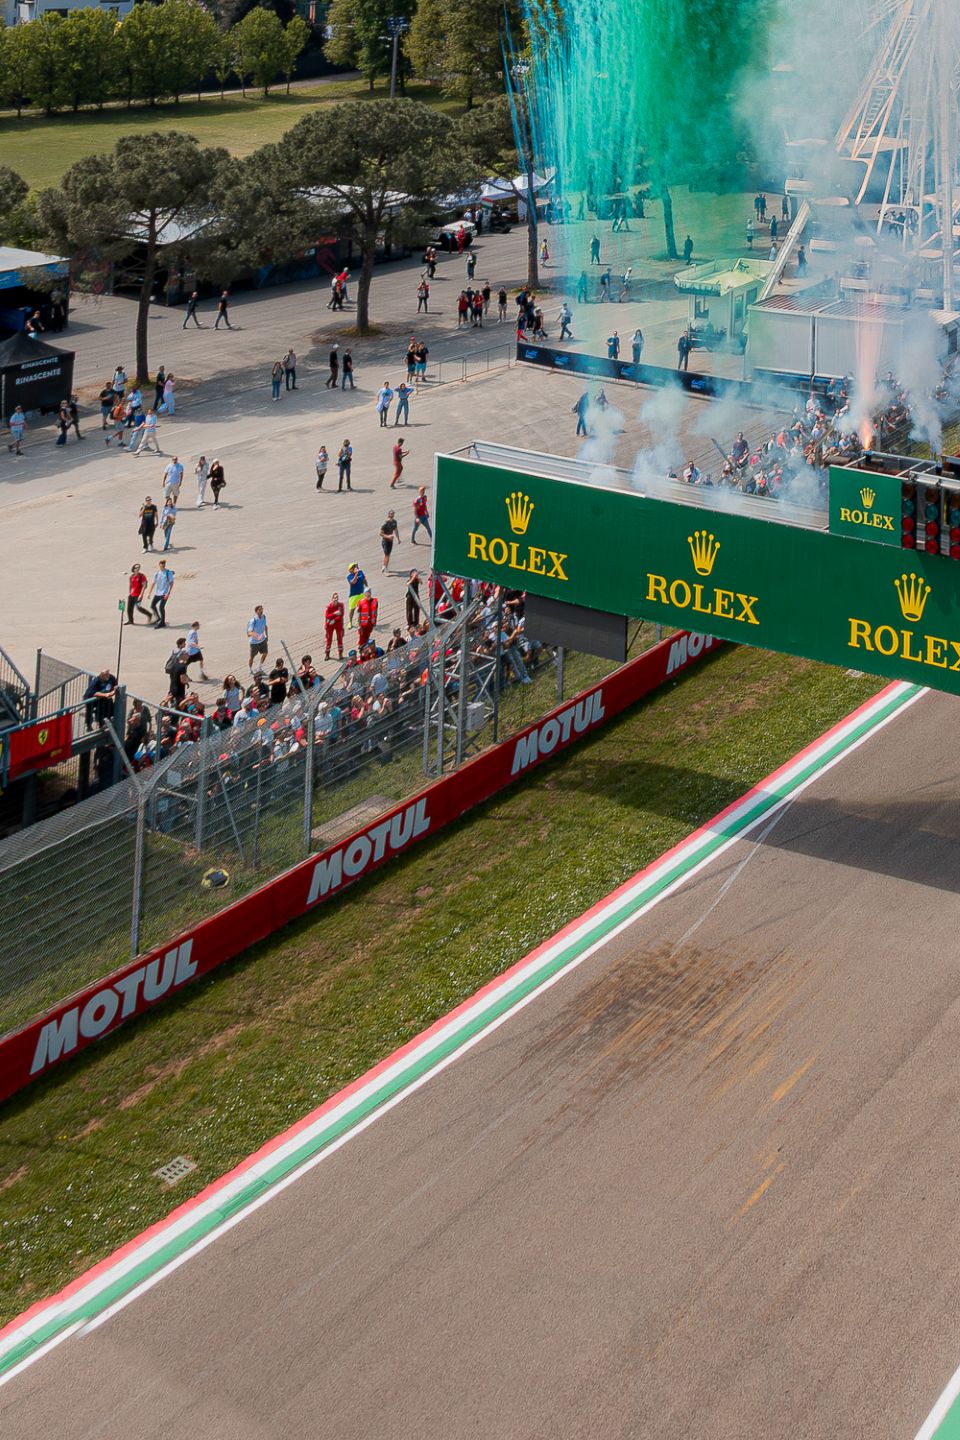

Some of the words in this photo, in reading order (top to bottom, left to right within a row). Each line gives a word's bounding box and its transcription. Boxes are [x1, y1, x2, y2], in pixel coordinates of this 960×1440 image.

[15, 368, 61, 385] RINASCENTE
[840, 508, 894, 530] ROLEX
[467, 532, 568, 581] ROLEX
[645, 573, 760, 625] ROLEX
[510, 689, 606, 775] MOTUL
[306, 797, 431, 905] MOTUL
[30, 938, 198, 1076] MOTUL
